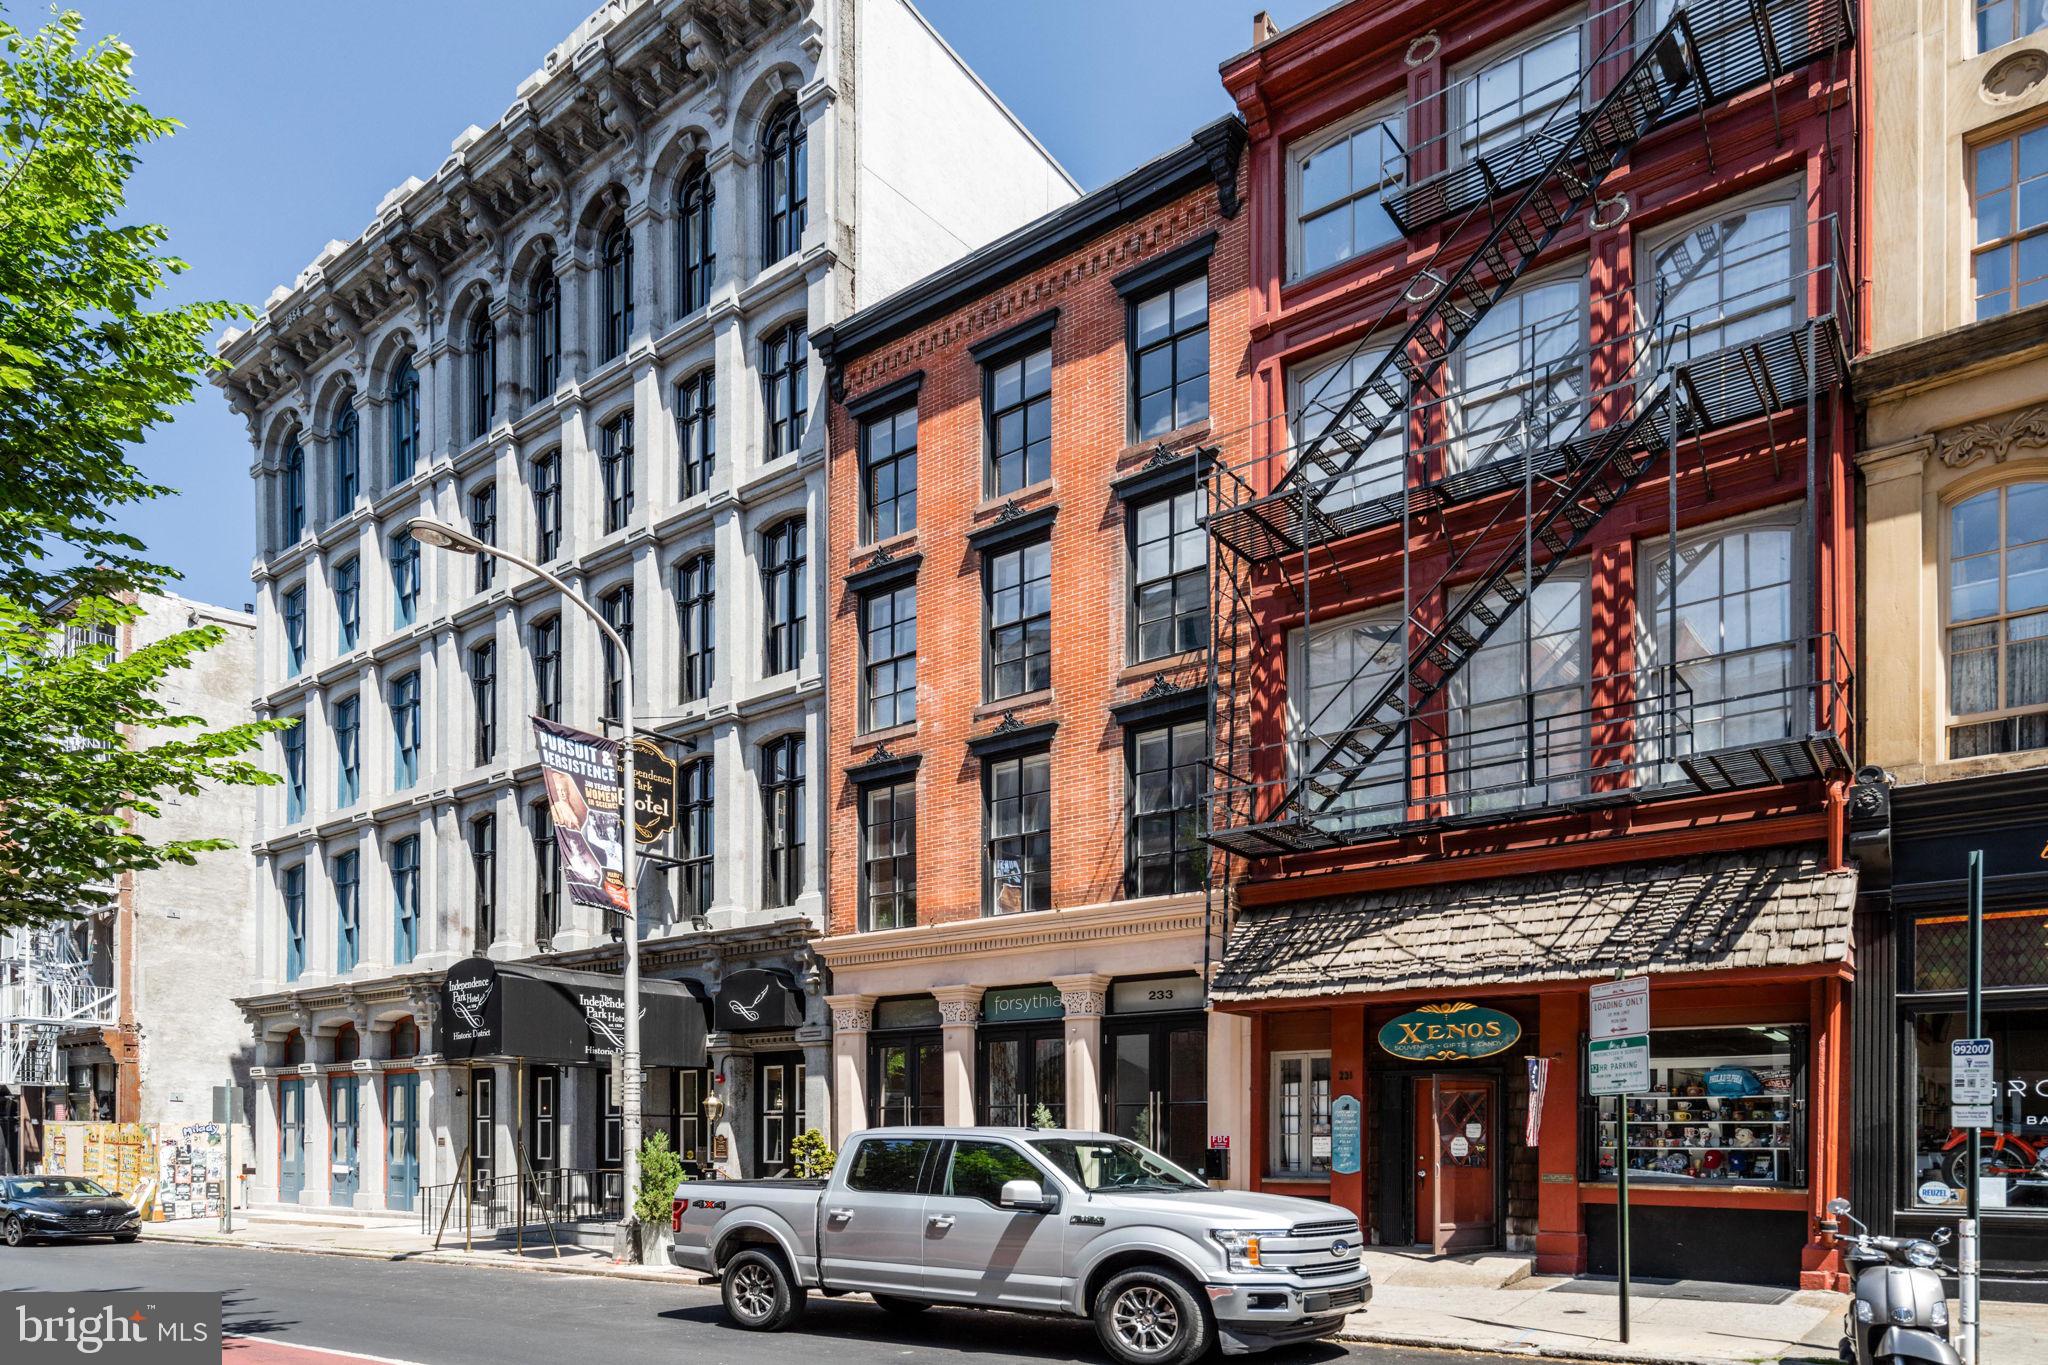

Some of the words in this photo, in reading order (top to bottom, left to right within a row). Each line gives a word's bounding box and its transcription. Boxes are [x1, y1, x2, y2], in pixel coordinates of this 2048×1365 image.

[540, 731, 597, 763] PURSUIT
[602, 750, 613, 767] &
[584, 787, 617, 802] WOMEN
[449, 976, 489, 992] Independence
[453, 991, 466, 1003] Park
[580, 994, 625, 1009] Independe
[600, 994, 613, 1002] The
[1149, 990, 1174, 1000] 233
[994, 992, 1062, 1014] forsythia
[1594, 999, 1623, 1011] LOADING
[1626, 996, 1644, 1006] ONLY
[586, 1006, 607, 1019] Park
[608, 1012, 625, 1022] Hote
[453, 1031, 472, 1040] Historic
[472, 1028, 491, 1038] District
[1397, 1021, 1502, 1045] XENOS
[585, 1046, 613, 1056] Historic
[1394, 1043, 1435, 1051] SOUVENIRS
[1954, 1044, 1990, 1055] 992007
[1610, 1061, 1638, 1070] PARKING
[182, 1121, 220, 1137] Milady
[1923, 1188, 1947, 1197] REUZEL
